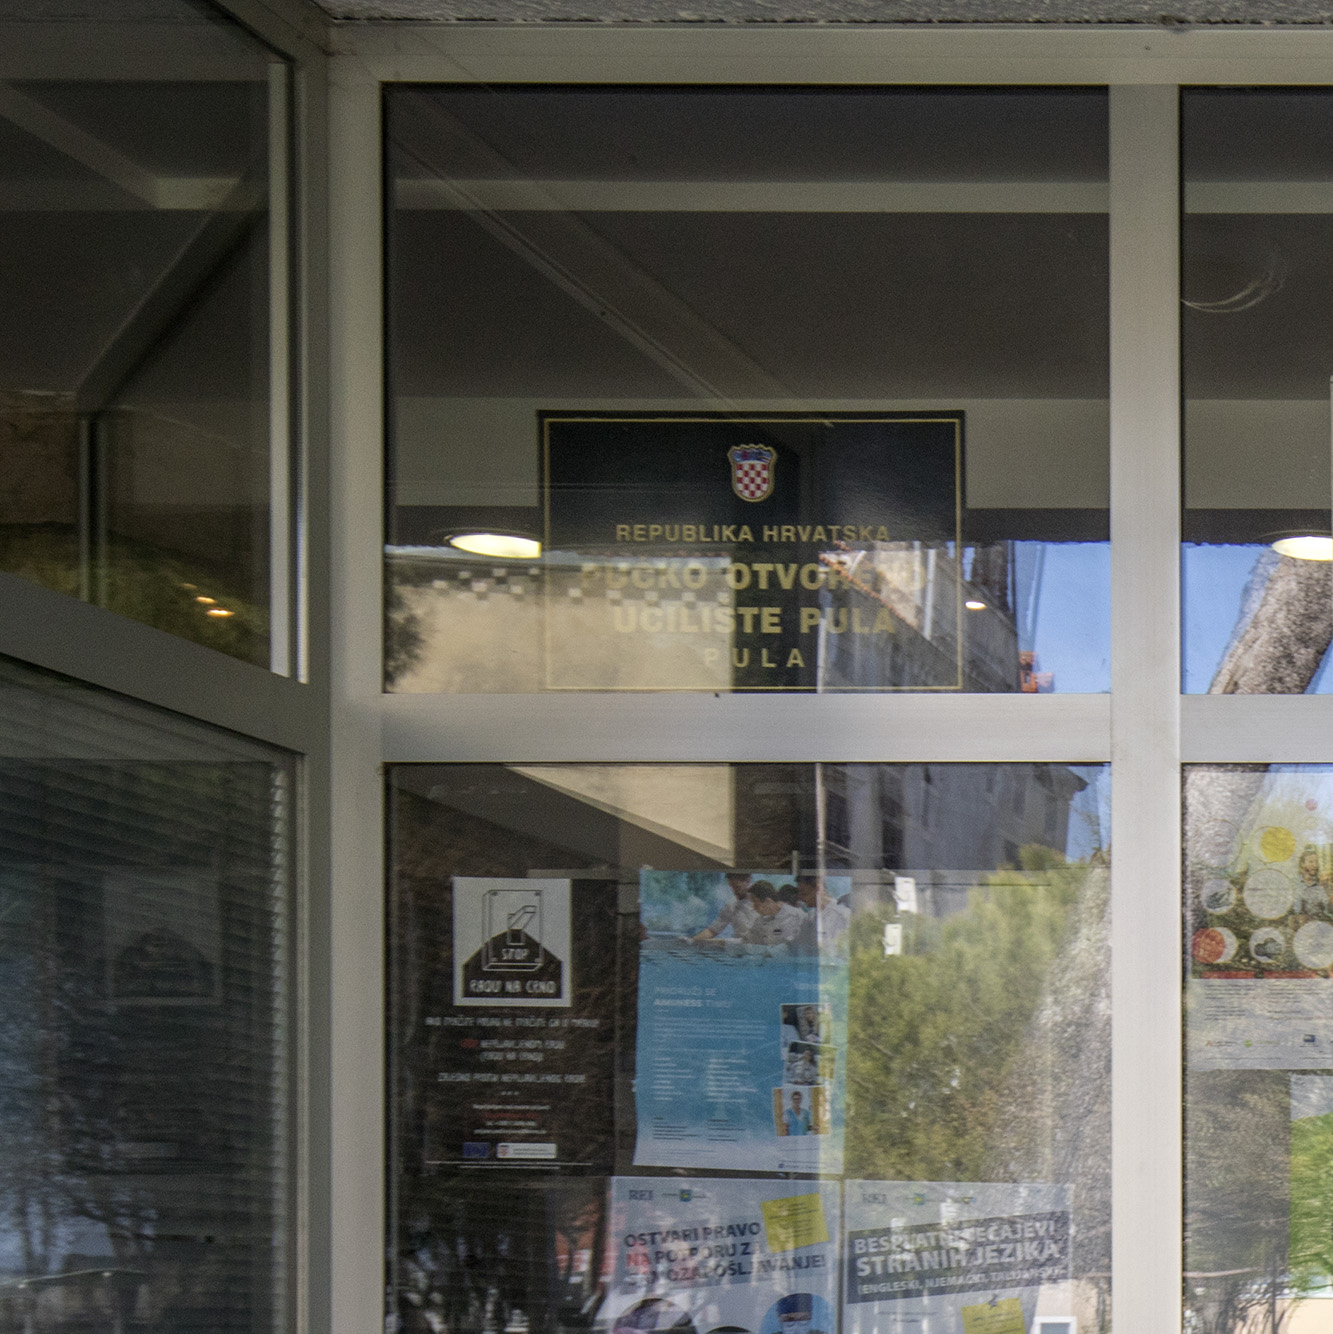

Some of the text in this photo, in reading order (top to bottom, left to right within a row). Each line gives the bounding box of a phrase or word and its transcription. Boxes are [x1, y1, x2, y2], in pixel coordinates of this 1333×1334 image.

[616, 524, 890, 542] REPUBLIKA HRVATSKA
[800, 607, 897, 634] PULA
[624, 1228, 699, 1248] OSTVARI
[703, 1222, 761, 1241] PRAVO
[856, 1240, 1062, 1277] STRANIH JEZIKA
